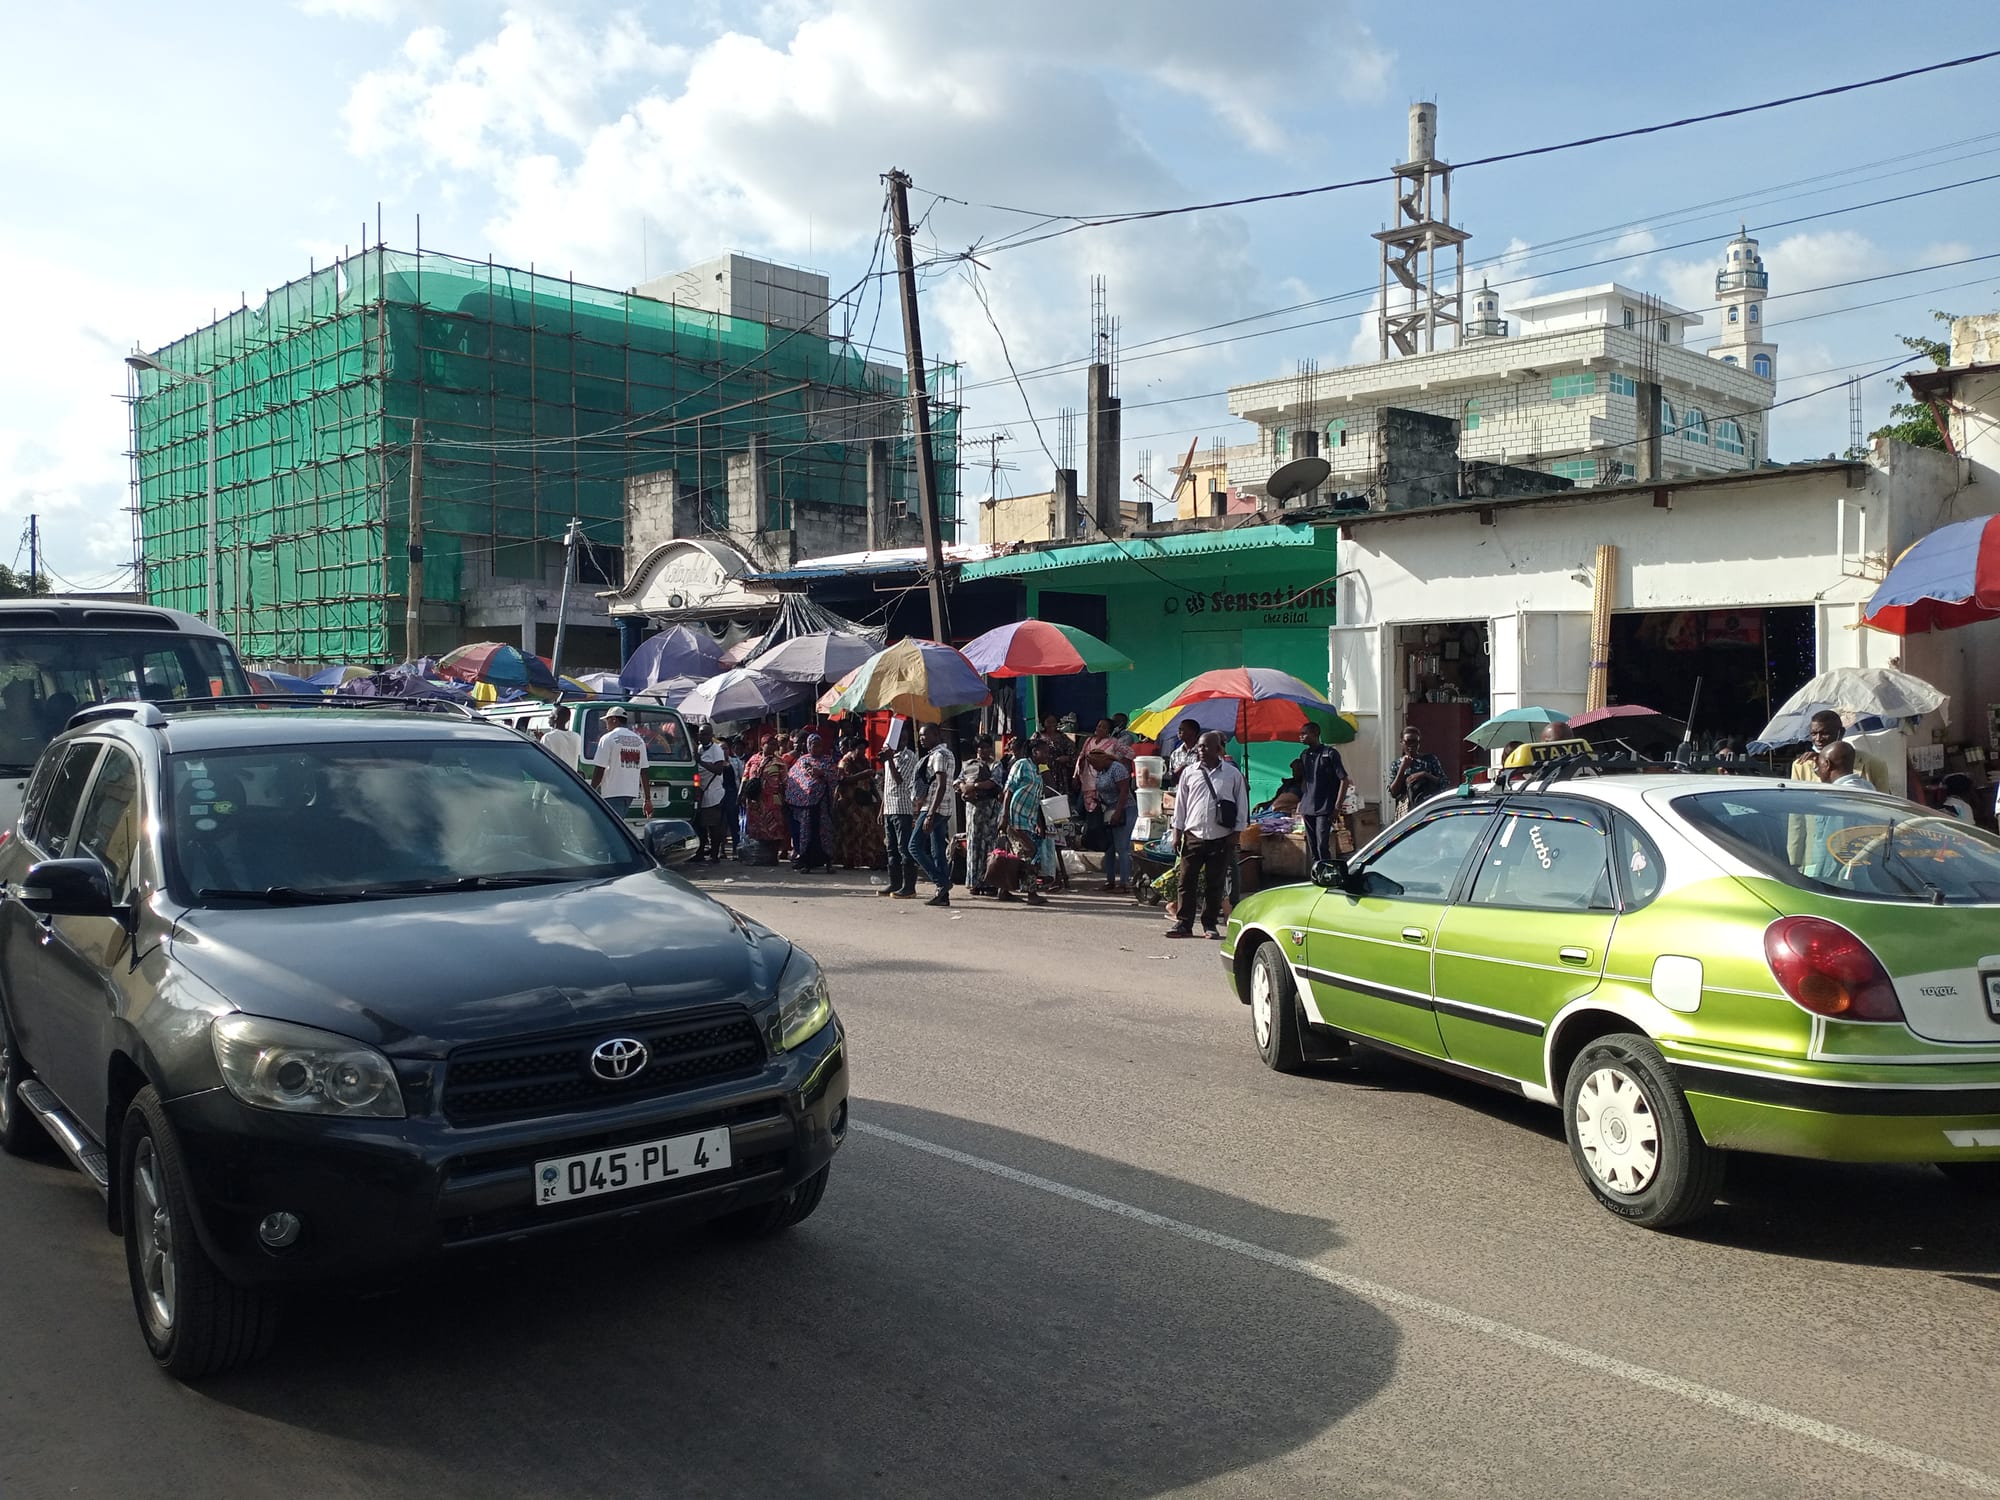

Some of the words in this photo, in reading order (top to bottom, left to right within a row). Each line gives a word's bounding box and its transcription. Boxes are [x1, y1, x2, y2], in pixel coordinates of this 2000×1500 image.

[1211, 585, 1337, 612] Sensations
[1534, 743, 1584, 761] TAXI
[1529, 825, 1551, 869] turbo
[1920, 985, 1958, 997] TOYOTA
[568, 1152, 628, 1195] 045
[643, 1144, 679, 1181] PL
[694, 1136, 710, 1168] 4
[543, 1186, 557, 1198] RC
